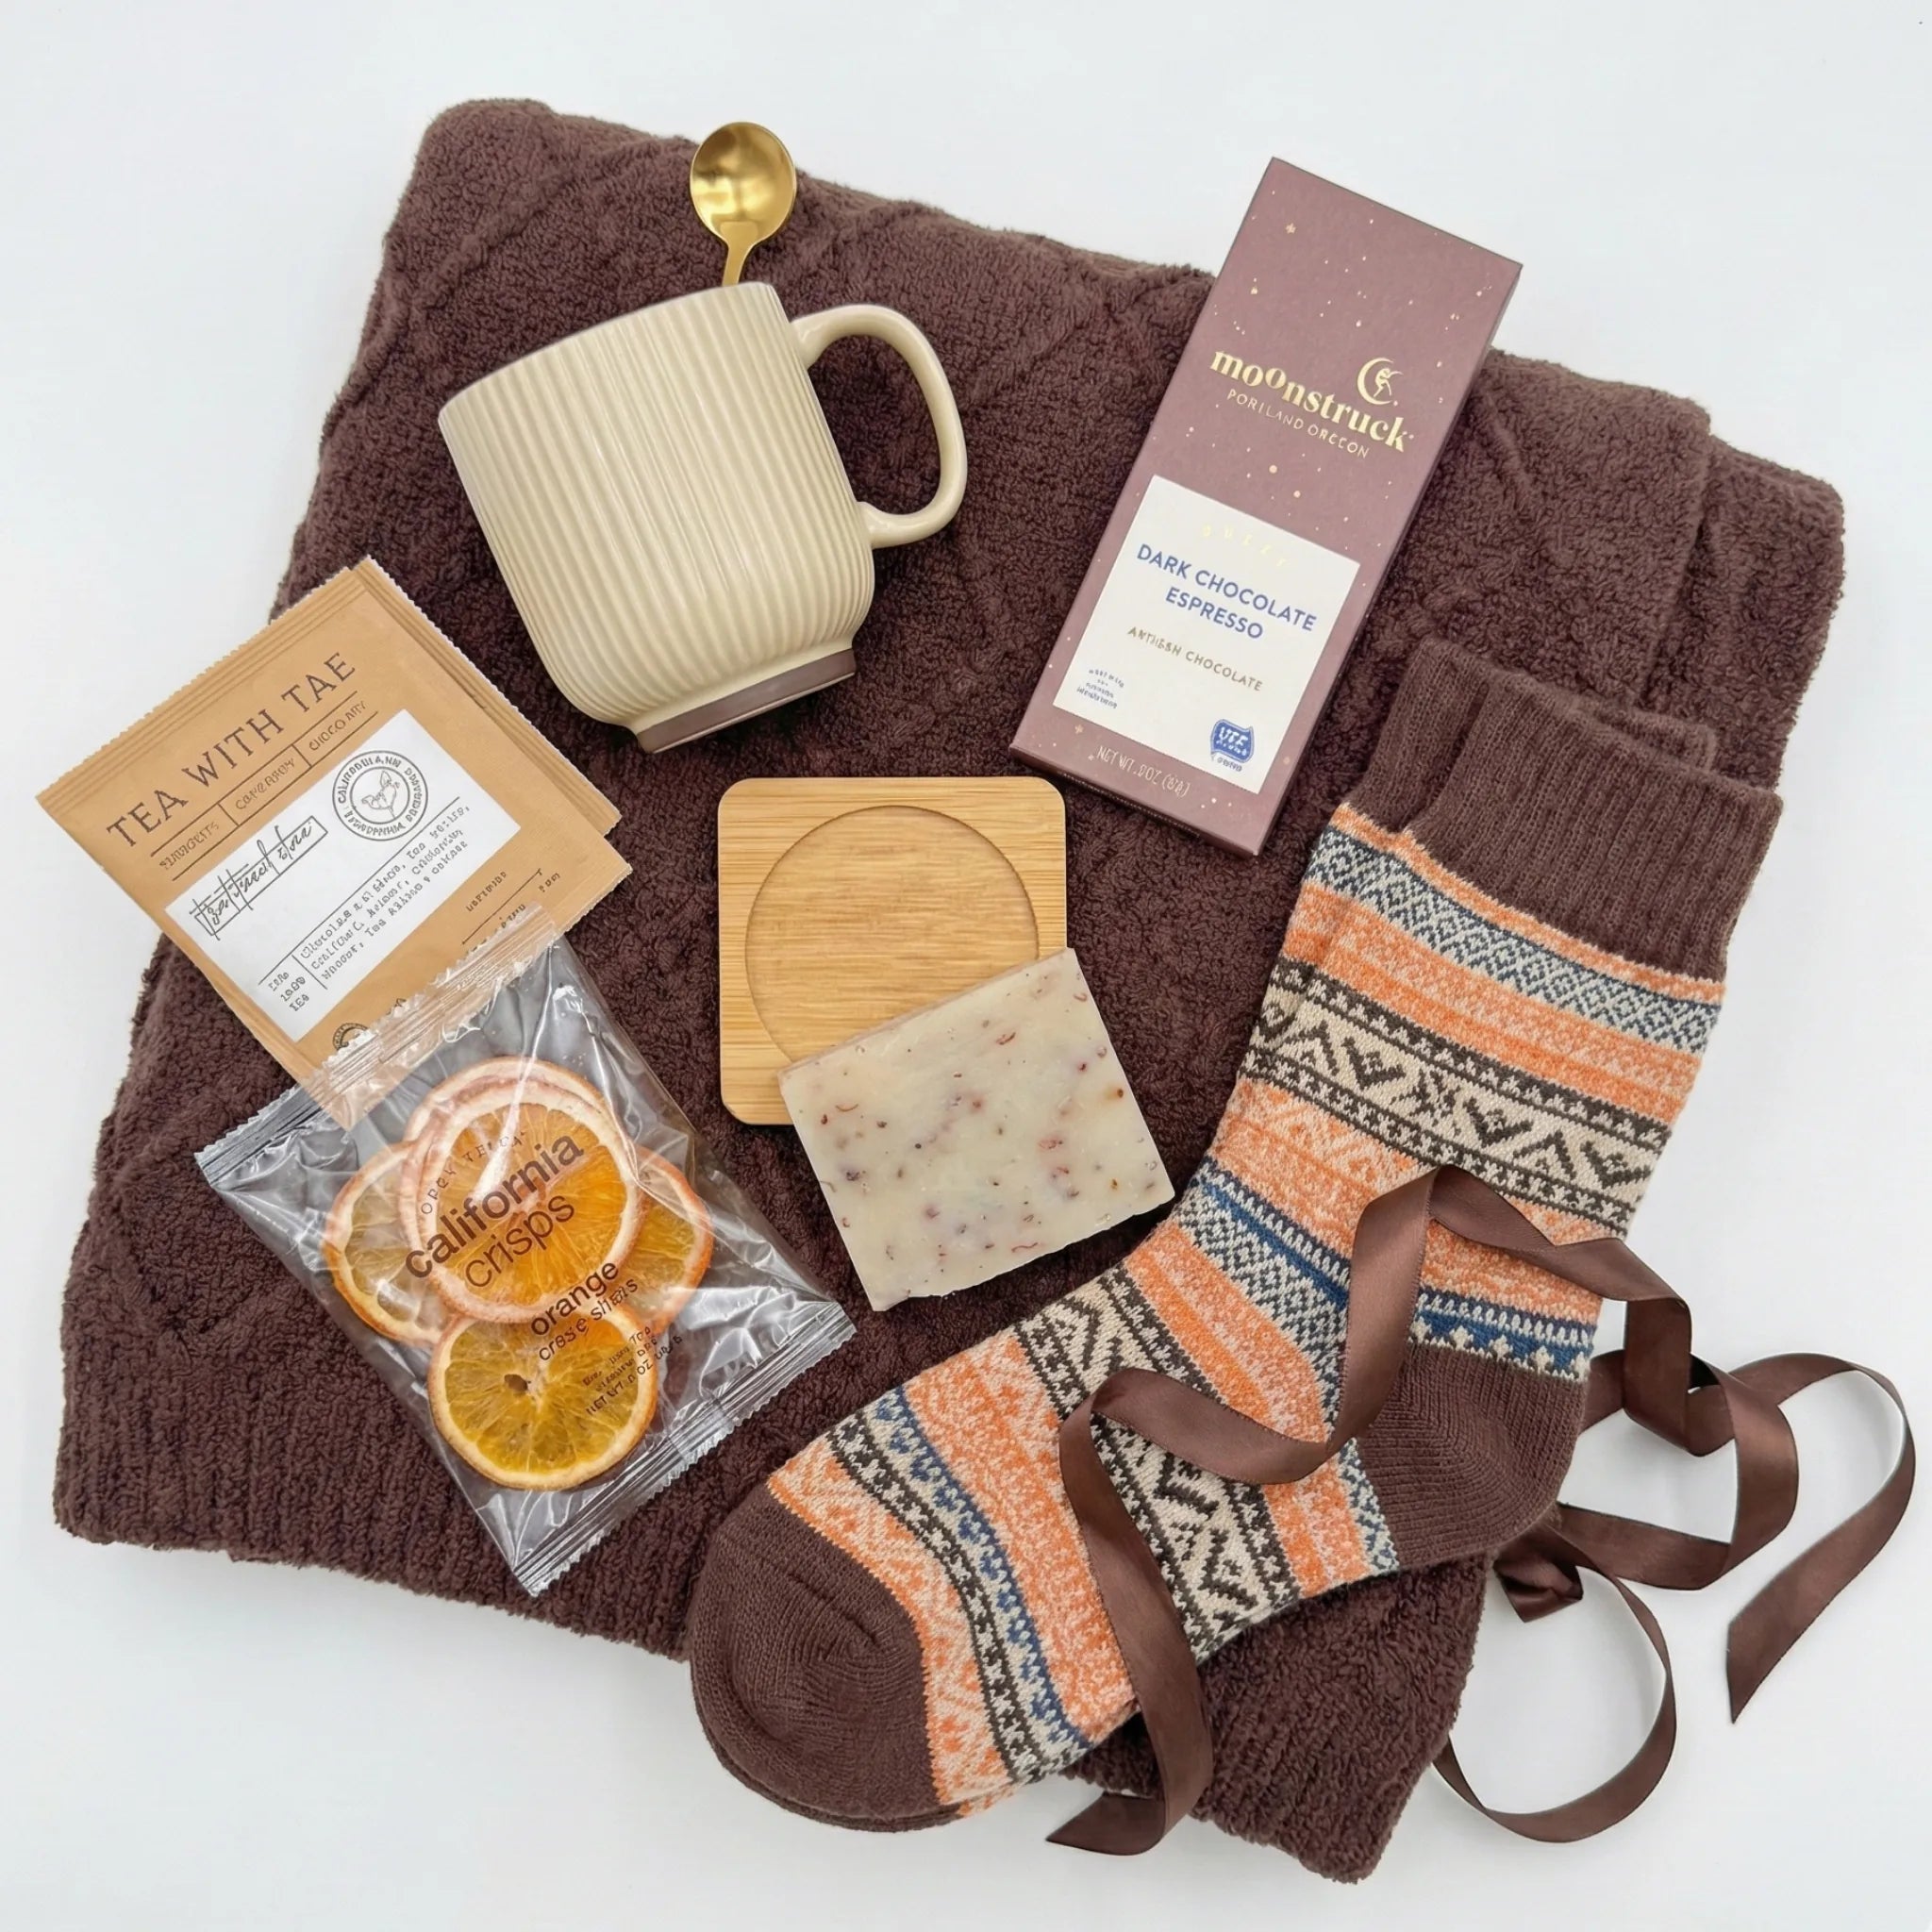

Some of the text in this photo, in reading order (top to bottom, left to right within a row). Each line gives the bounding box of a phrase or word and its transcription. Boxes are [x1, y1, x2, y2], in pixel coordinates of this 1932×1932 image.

[1208, 350, 1410, 453] moonstruck
[1135, 542, 1192, 579] DARK
[1191, 567, 1317, 633] CHOCOLATE
[1164, 585, 1266, 641] ESPRESSO
[1183, 649, 1264, 692] CHOCOLATE
[105, 788, 190, 847] TEA
[180, 708, 284, 789] WITH
[280, 650, 357, 713] TAE
[405, 1137, 586, 1277] california
[464, 1193, 575, 1286] crisps
[531, 1259, 619, 1334] orange
